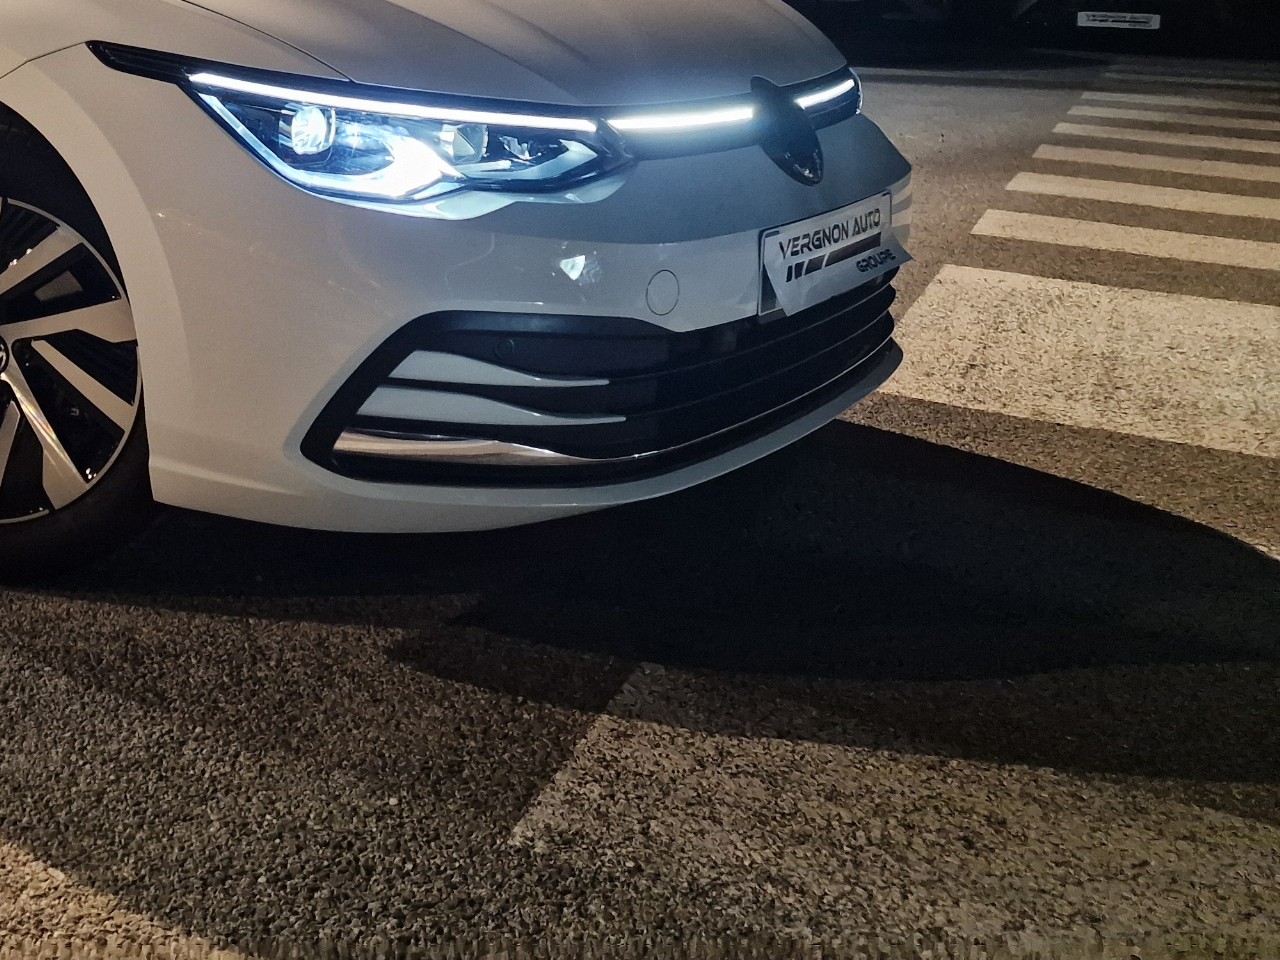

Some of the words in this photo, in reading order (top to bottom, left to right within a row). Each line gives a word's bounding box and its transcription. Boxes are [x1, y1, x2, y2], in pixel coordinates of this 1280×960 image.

[779, 220, 849, 260] VERGNON
[852, 208, 881, 237] AUTO
[855, 248, 897, 273] GROUPE
